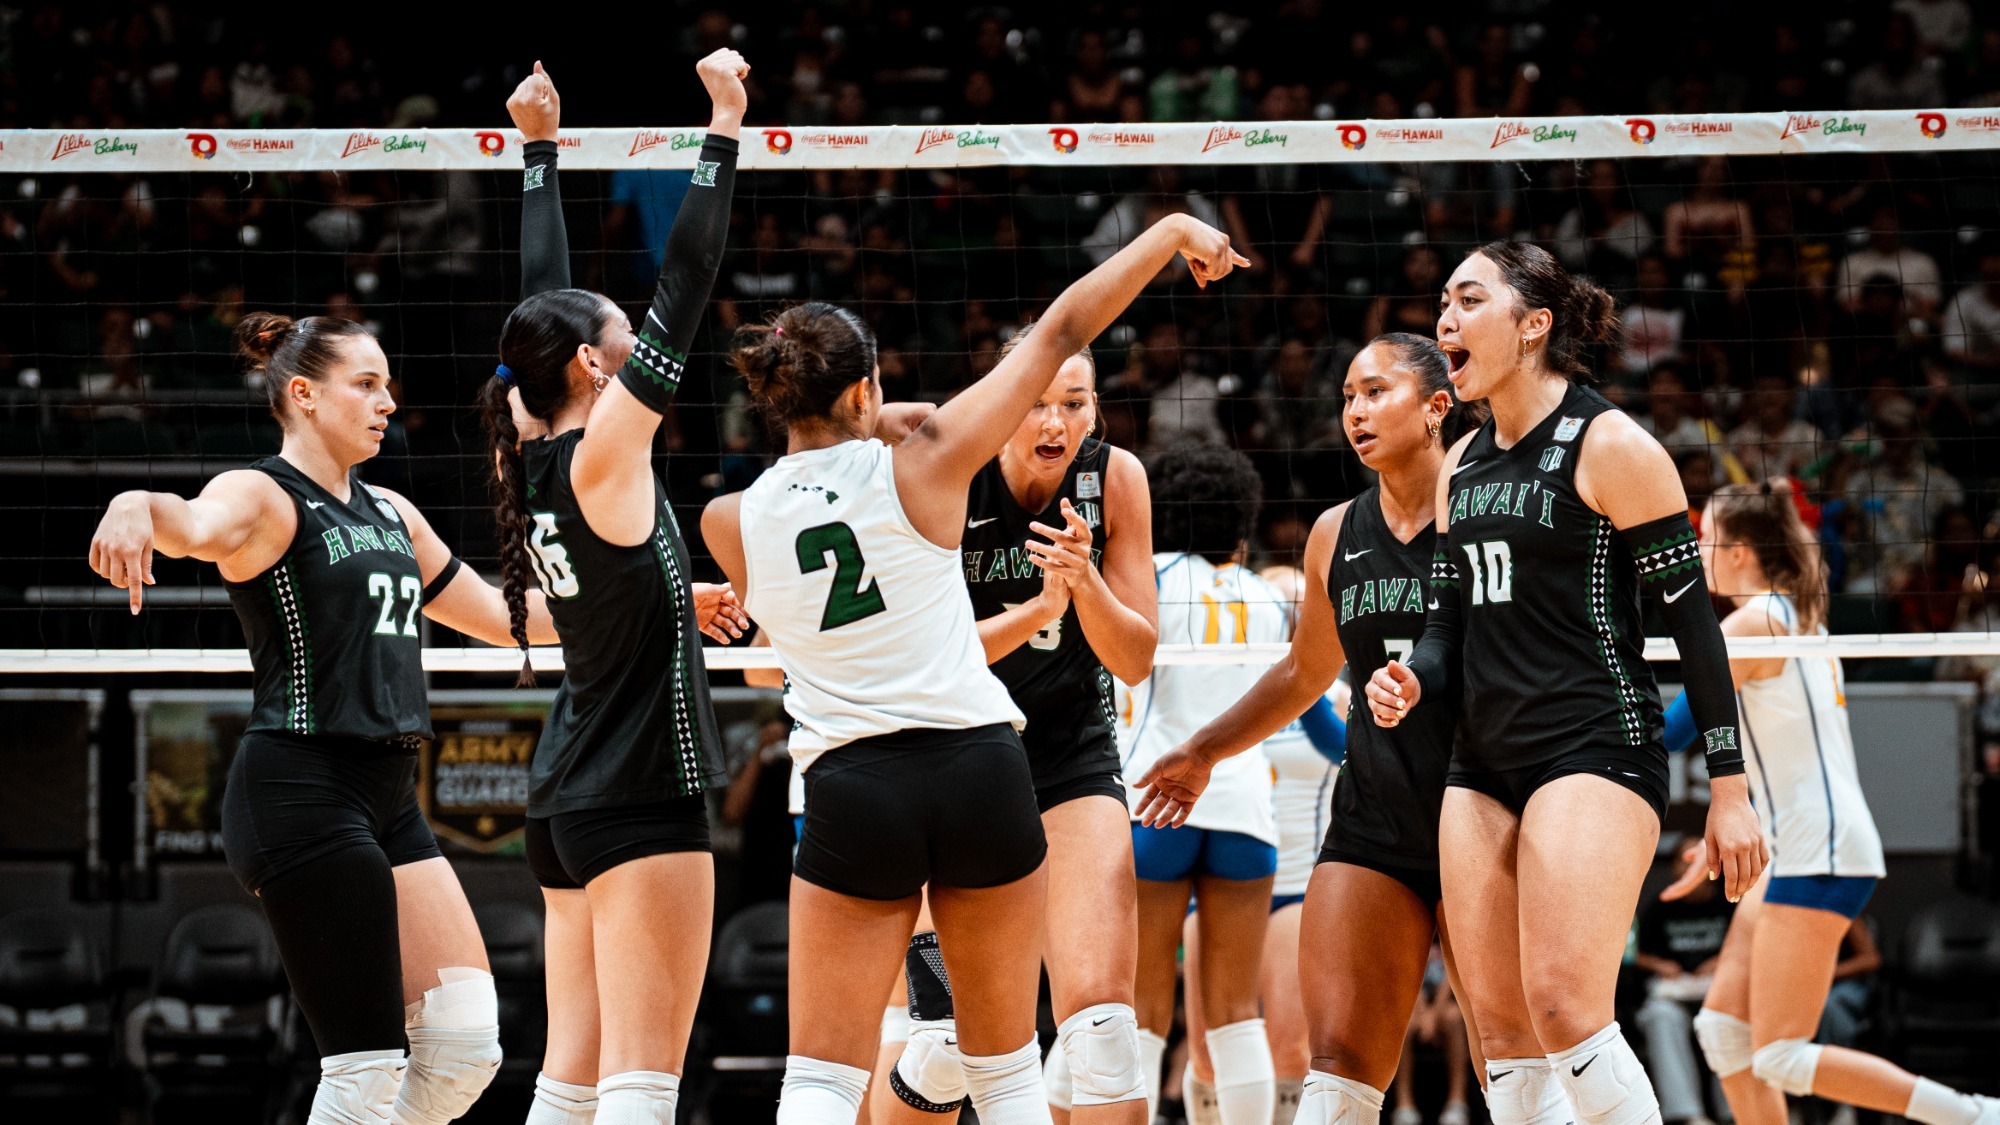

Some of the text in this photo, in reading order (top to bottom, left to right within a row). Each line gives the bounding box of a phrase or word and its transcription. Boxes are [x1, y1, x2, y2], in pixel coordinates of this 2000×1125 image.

[1402, 128, 1443, 140] HAWAII
[1532, 123, 1577, 143] Bakery
[1691, 121, 1733, 133] HAWAII
[1822, 117, 1867, 137] Bakery
[93, 137, 138, 156] Bakery
[253, 139, 294, 150] HAWAII
[382, 135, 427, 153] Bakery
[557, 137, 581, 147] WAII
[669, 132, 706, 151] Baker
[827, 134, 869, 145] HAWAII
[956, 130, 1001, 149] Bakery
[1114, 132, 1155, 144] HAWAII
[1243, 128, 1288, 148] Bakery
[795, 520, 887, 632] 2
[1460, 539, 1514, 606] 10
[368, 571, 422, 638] 22
[1340, 578, 1424, 626] HAWA
[1201, 592, 1248, 645] 11
[1382, 637, 1415, 667] 7
[437, 733, 534, 764] ARMY
[1703, 726, 1738, 755] H
